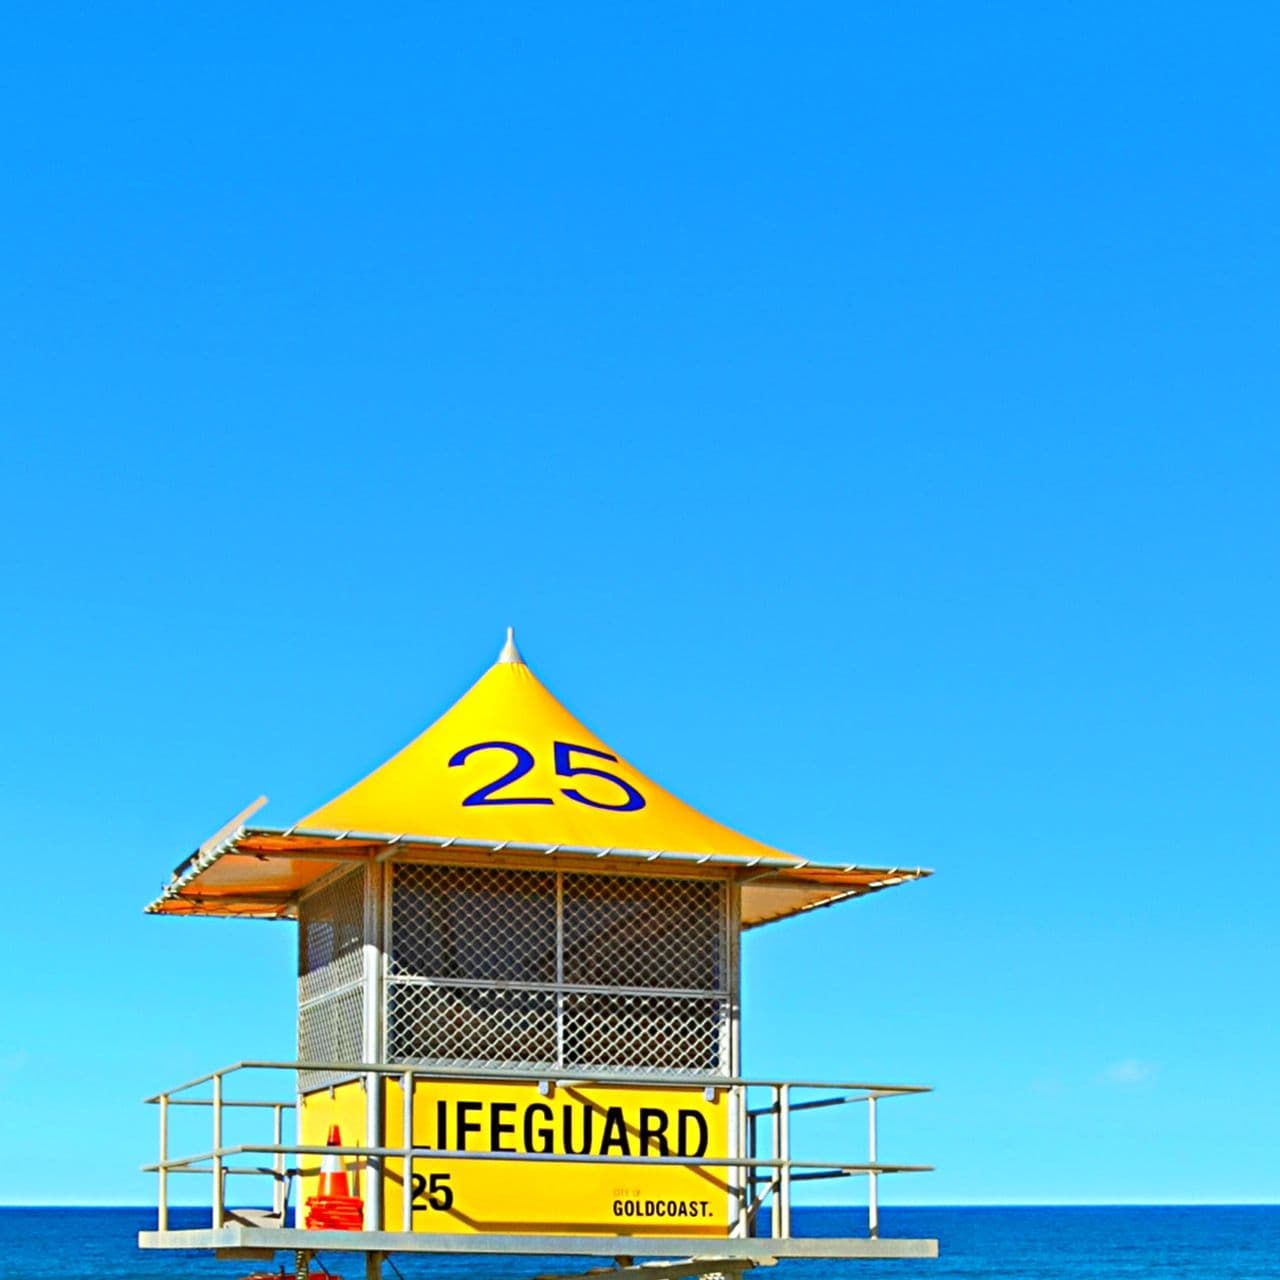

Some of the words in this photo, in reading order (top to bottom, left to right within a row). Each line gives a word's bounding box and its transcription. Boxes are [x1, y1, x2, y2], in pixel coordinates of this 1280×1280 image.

[448, 740, 646, 812] 25
[411, 1100, 709, 1157] IFEGUARD
[411, 1173, 454, 1211] 25
[613, 1199, 713, 1217] GOLDCOAST.
